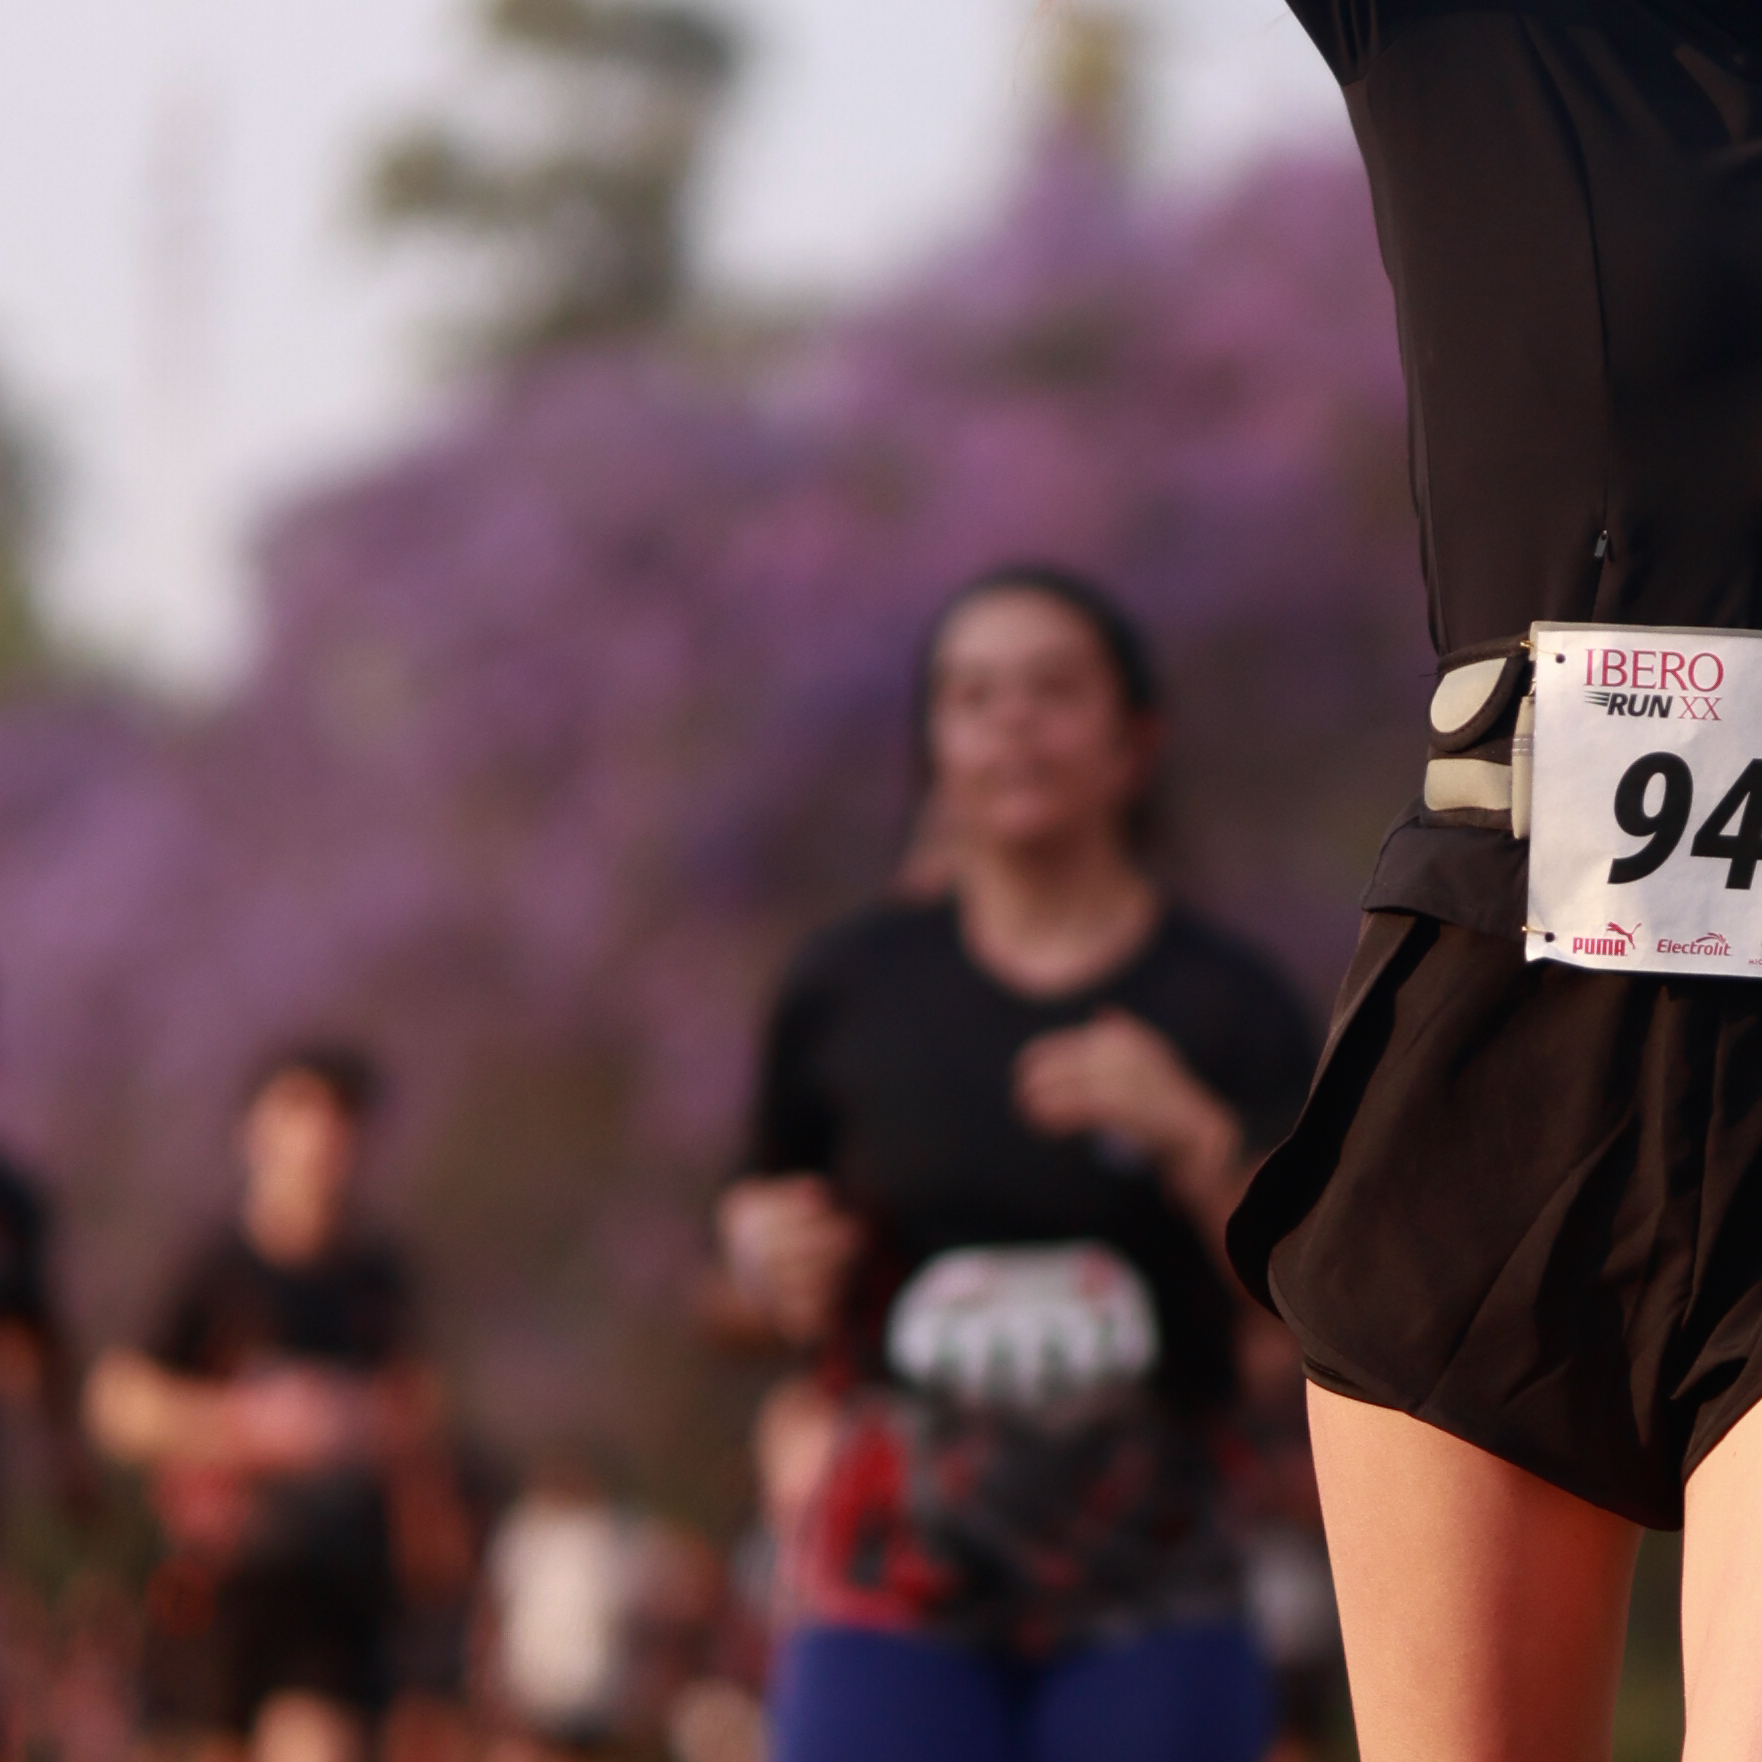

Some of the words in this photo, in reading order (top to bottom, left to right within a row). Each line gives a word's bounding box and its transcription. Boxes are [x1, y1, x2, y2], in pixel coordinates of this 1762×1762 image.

[1583, 648, 1725, 692] IBERO
[1606, 692, 1674, 719] RUN
[1677, 695, 1723, 721] XX
[1572, 936, 1626, 957] PUMA
[1656, 937, 1732, 956] Electrolit
